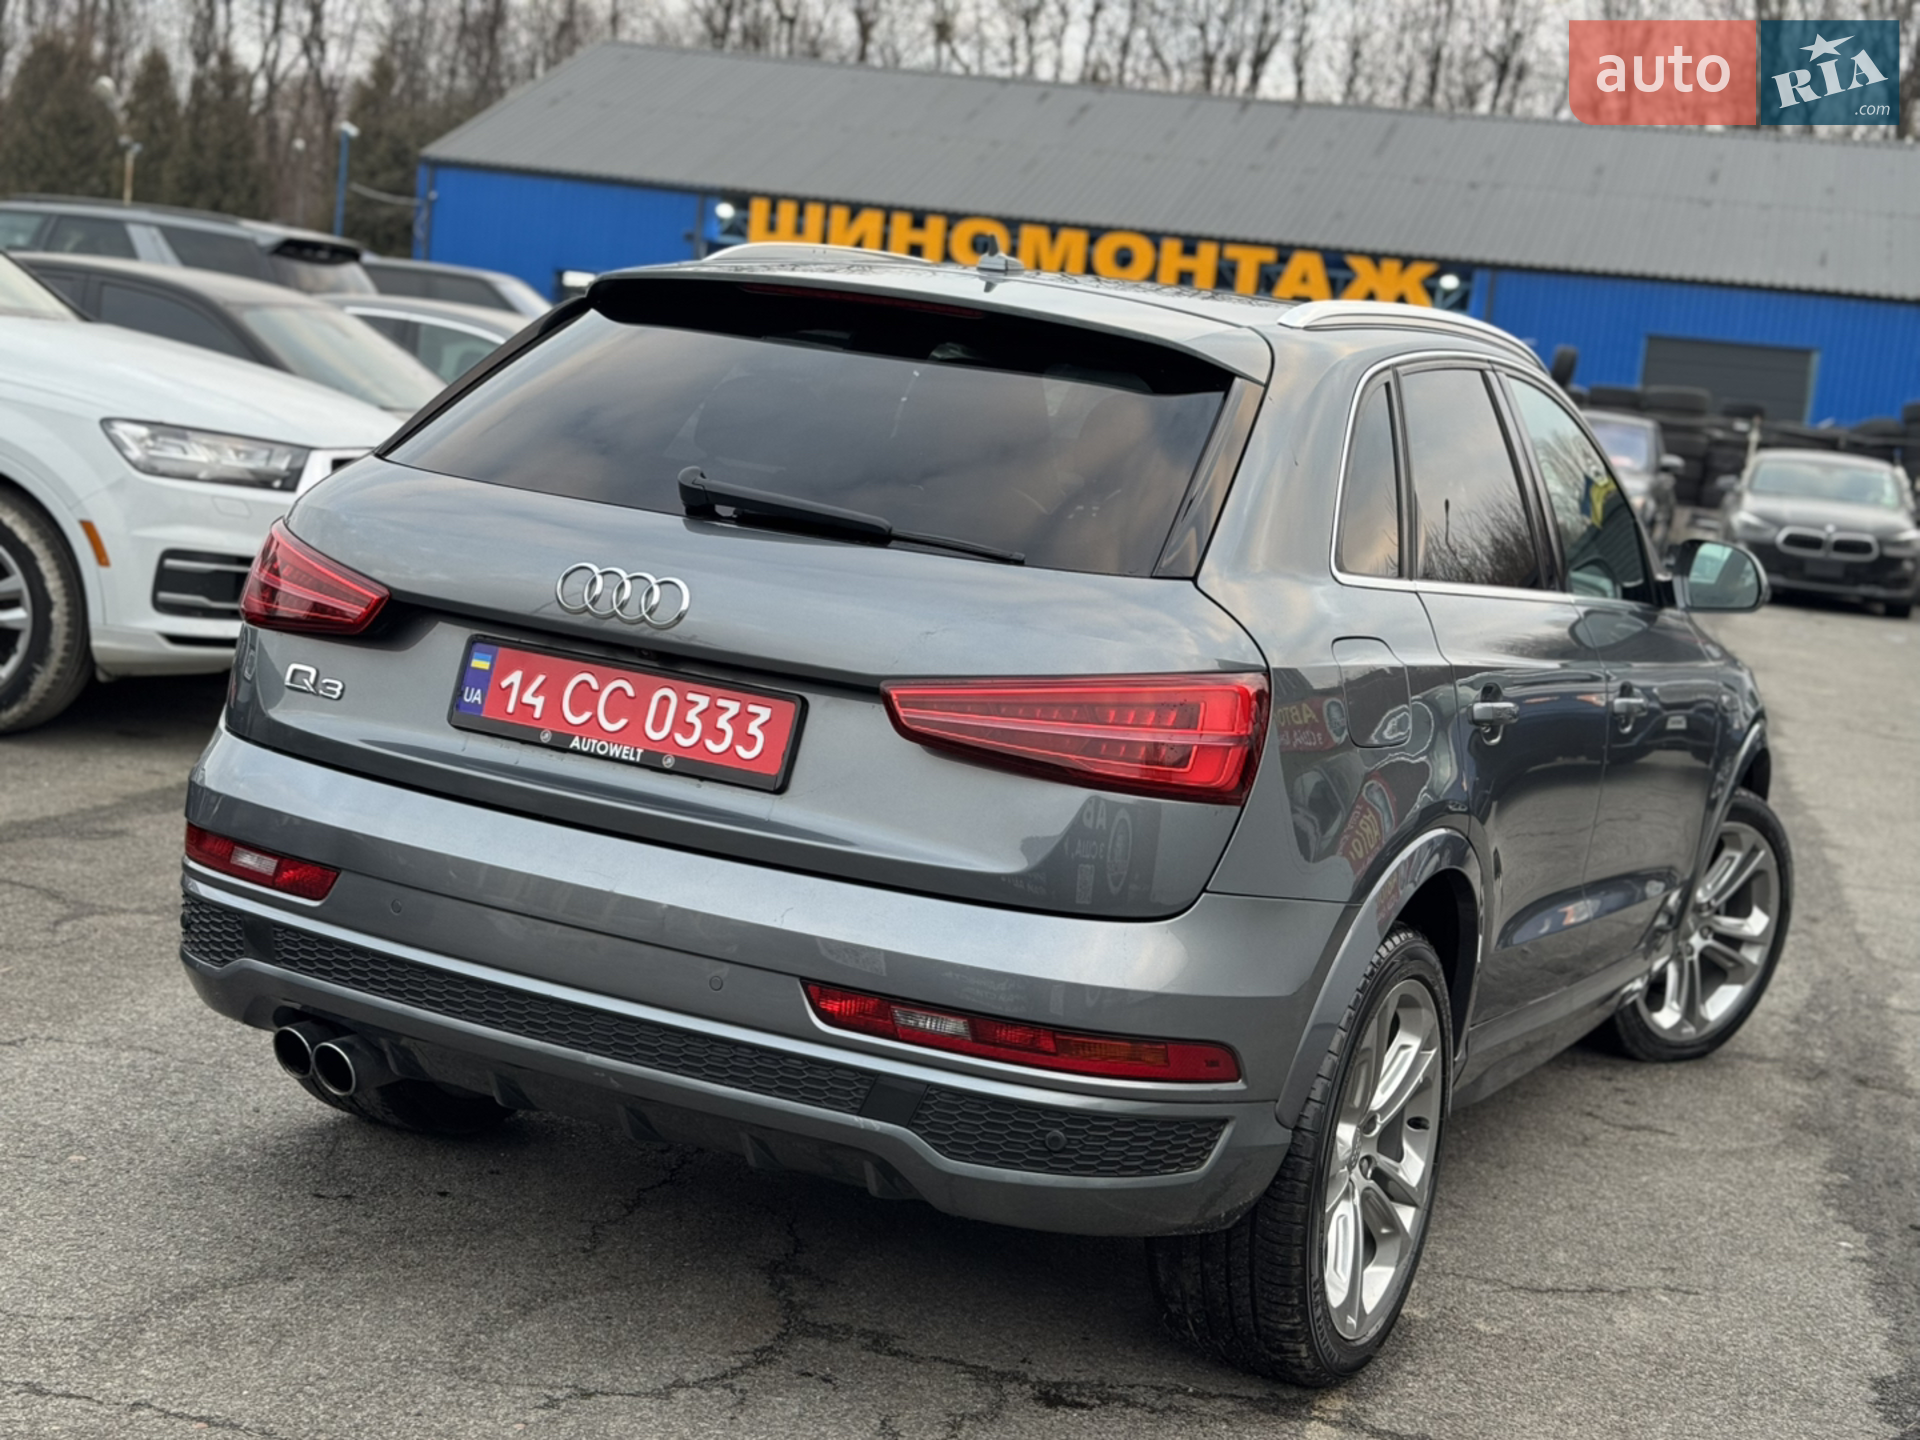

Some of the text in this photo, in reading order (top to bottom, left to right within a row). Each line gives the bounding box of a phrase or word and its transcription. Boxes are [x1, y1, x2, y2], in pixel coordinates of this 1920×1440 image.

[746, 196, 1440, 307] ШИНОМОНТАЖ
[284, 662, 345, 700] Q3
[463, 686, 482, 706] UA
[499, 669, 772, 761] 14 CC 0333
[569, 735, 644, 762] AUTOWELT
